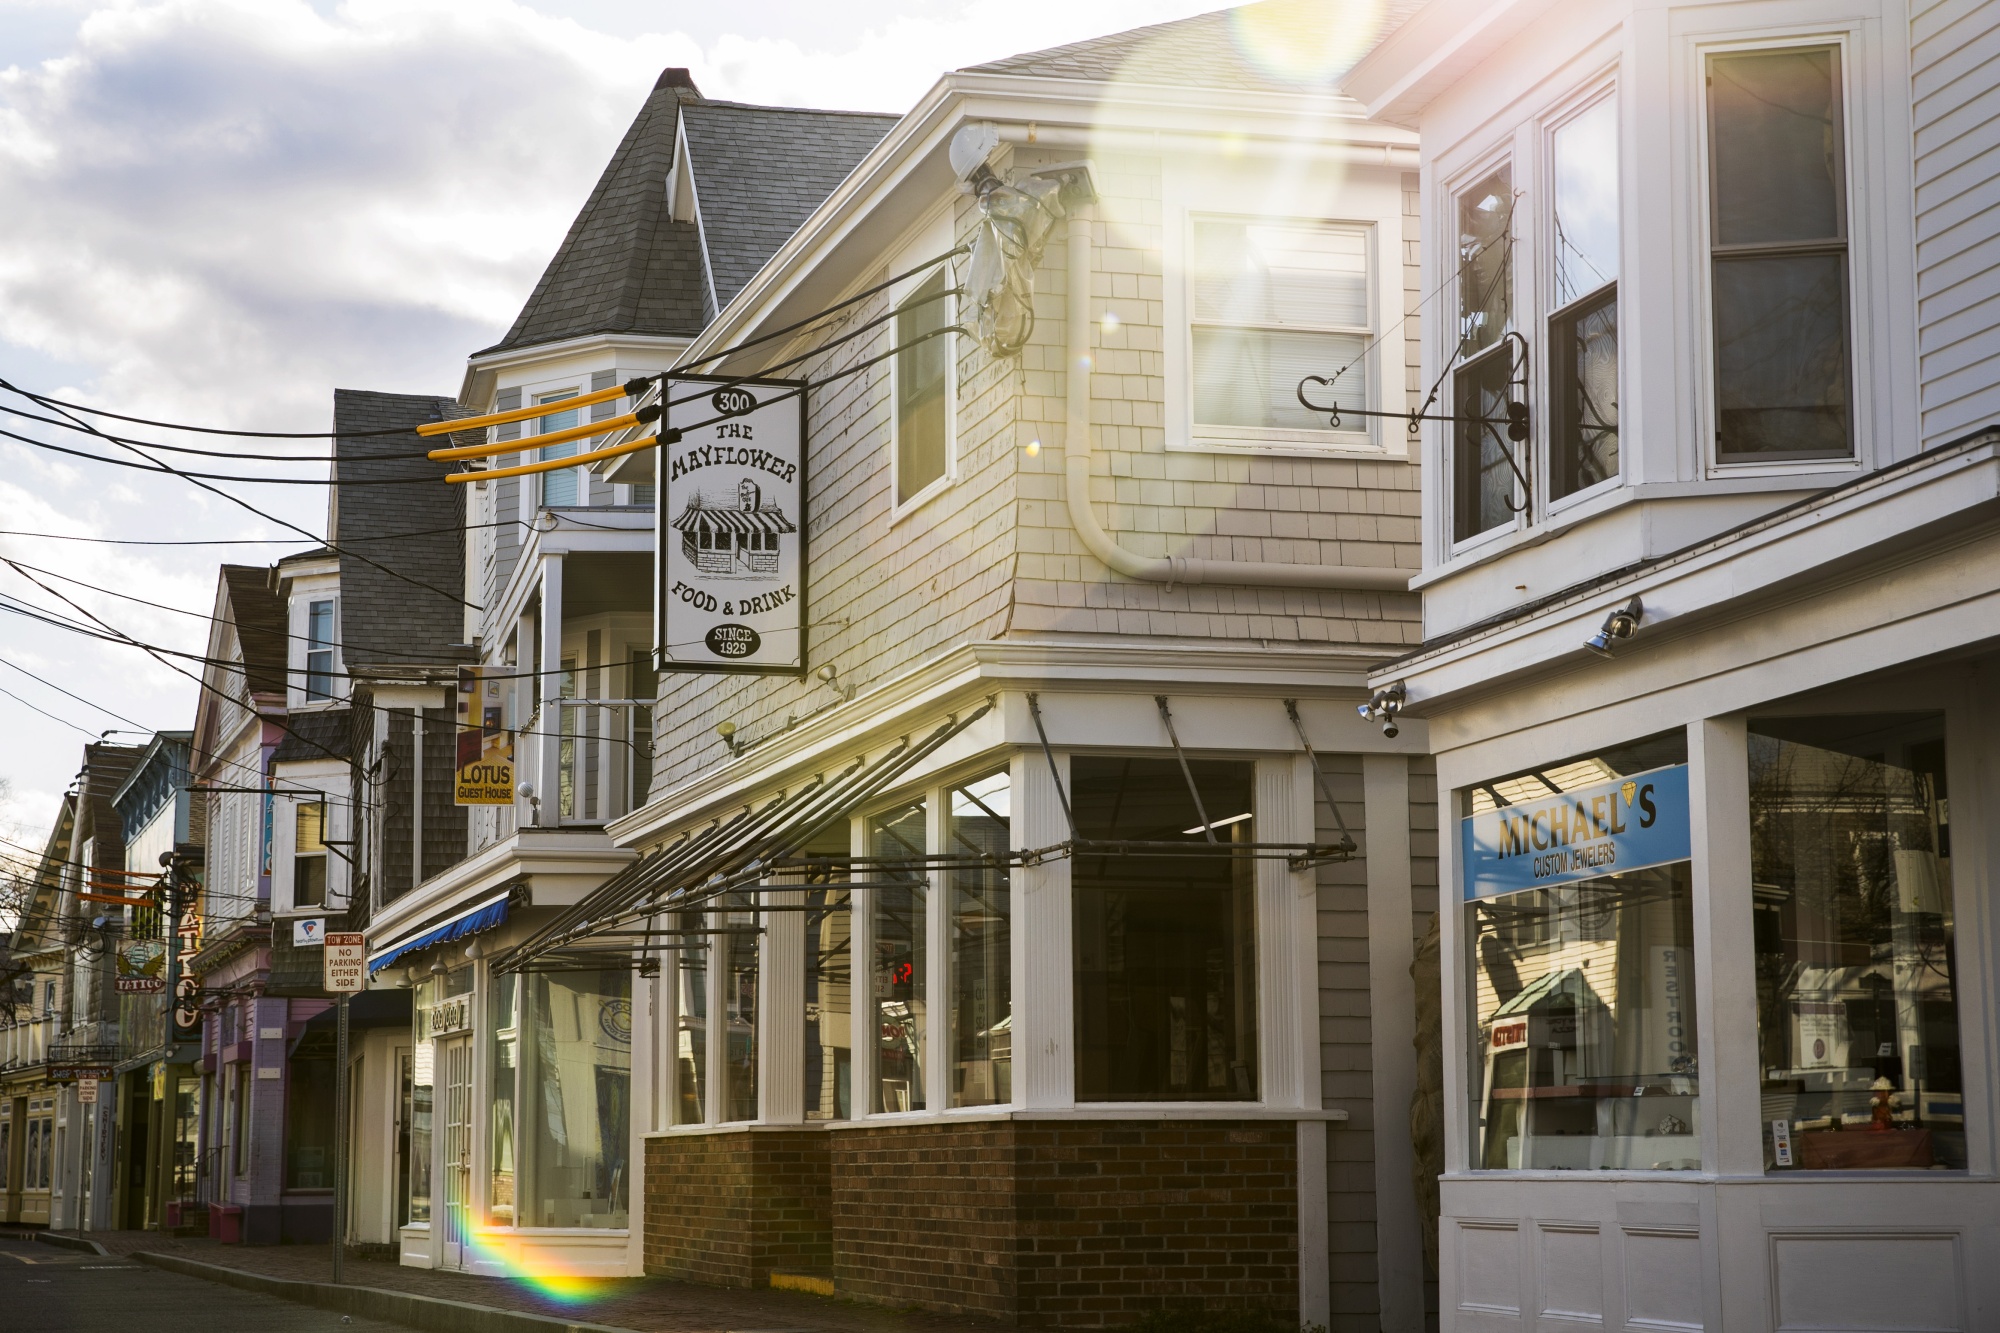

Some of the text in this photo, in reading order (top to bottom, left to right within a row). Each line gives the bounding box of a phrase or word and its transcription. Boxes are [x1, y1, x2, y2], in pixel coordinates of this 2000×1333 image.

[719, 392, 749, 412] 300
[716, 424, 753, 440] THE
[671, 445, 797, 483] MAYFLOWER
[671, 581, 796, 616] FOOD & DRINK
[714, 627, 752, 642] SINCE
[720, 642, 747, 655] 1929
[460, 765, 510, 784] LOTUS
[1498, 781, 1657, 860] MICHAEL'S
[1534, 841, 1616, 879] CUSTOM JEWELERS
[327, 936, 341, 944] TOW
[344, 935, 362, 944] ZONE
[338, 949, 352, 957] NO
[329, 958, 362, 967] PARKING
[331, 969, 359, 977] EITHER
[117, 979, 162, 990] TATTOO
[335, 978, 355, 987] SIDE
[52, 1069, 71, 1078] SHOP
